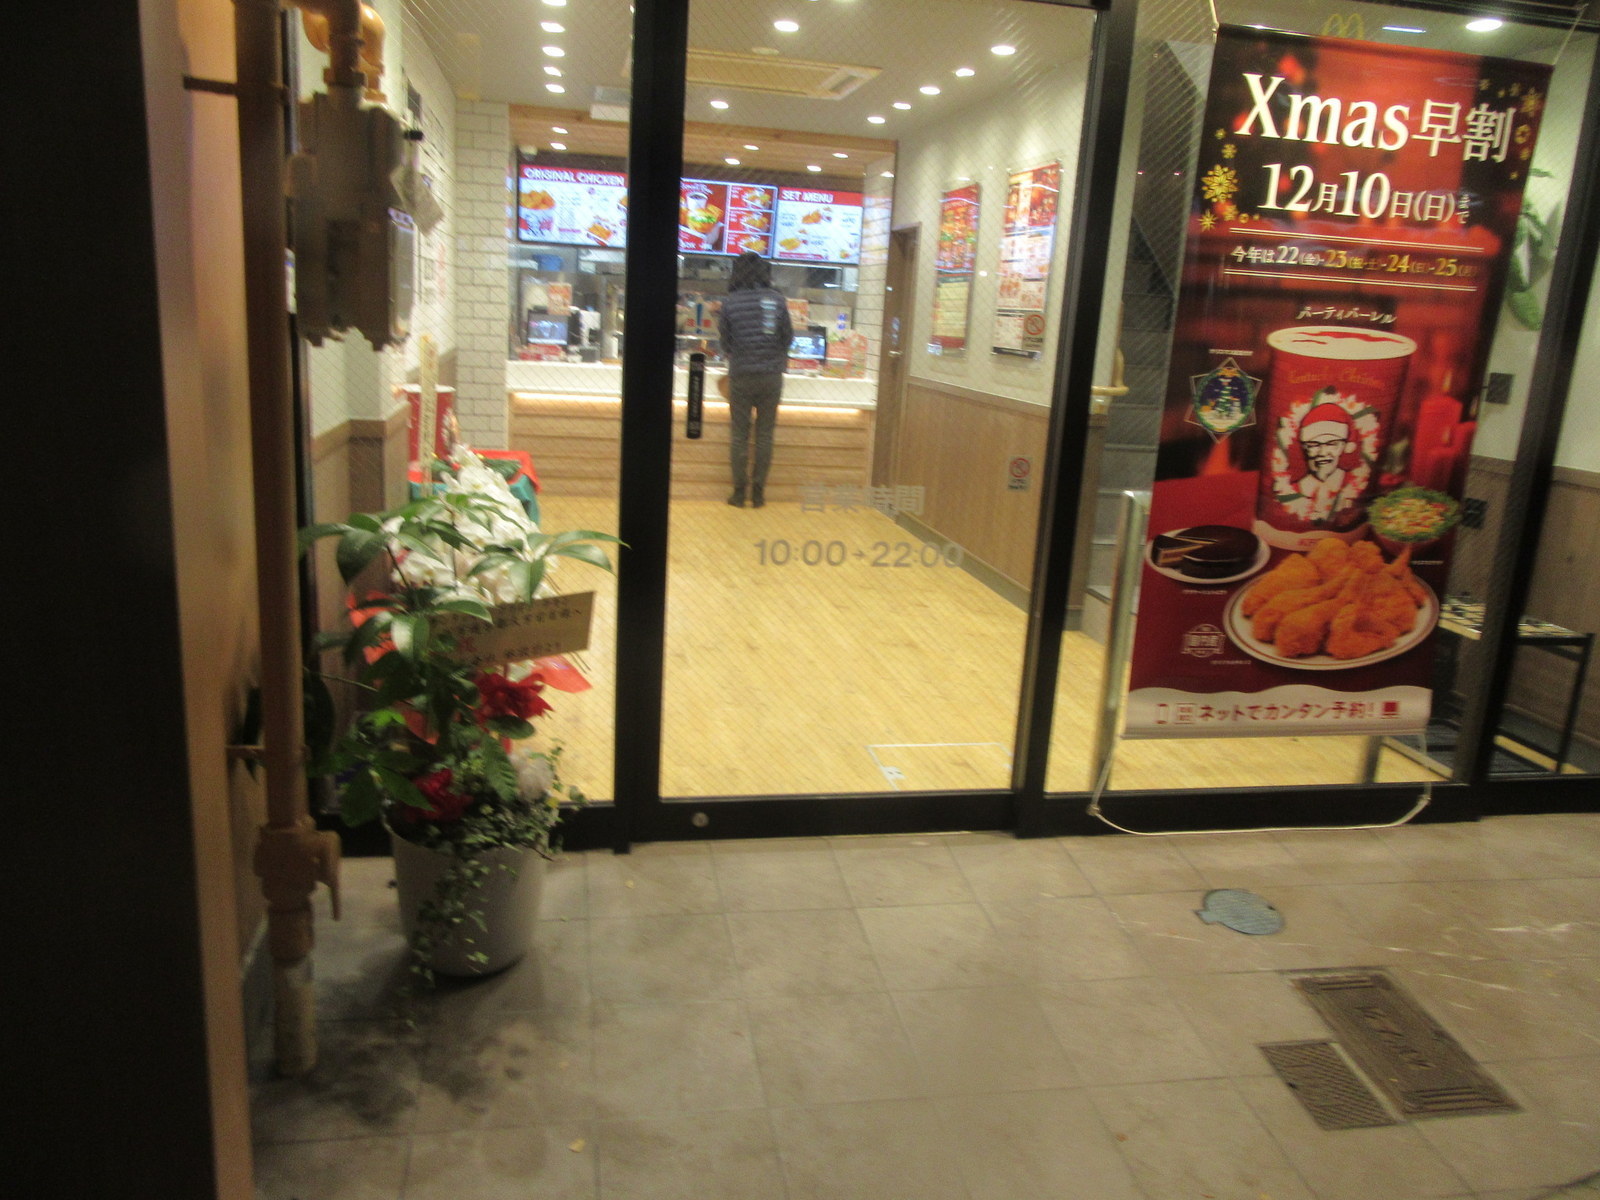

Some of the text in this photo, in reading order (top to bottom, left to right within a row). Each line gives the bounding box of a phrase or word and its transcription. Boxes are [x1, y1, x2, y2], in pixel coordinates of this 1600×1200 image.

[576, 172, 625, 187] CHICKEN
[781, 190, 834, 204] SET MENU
[753, 538, 965, 569] 10:00 22:00
